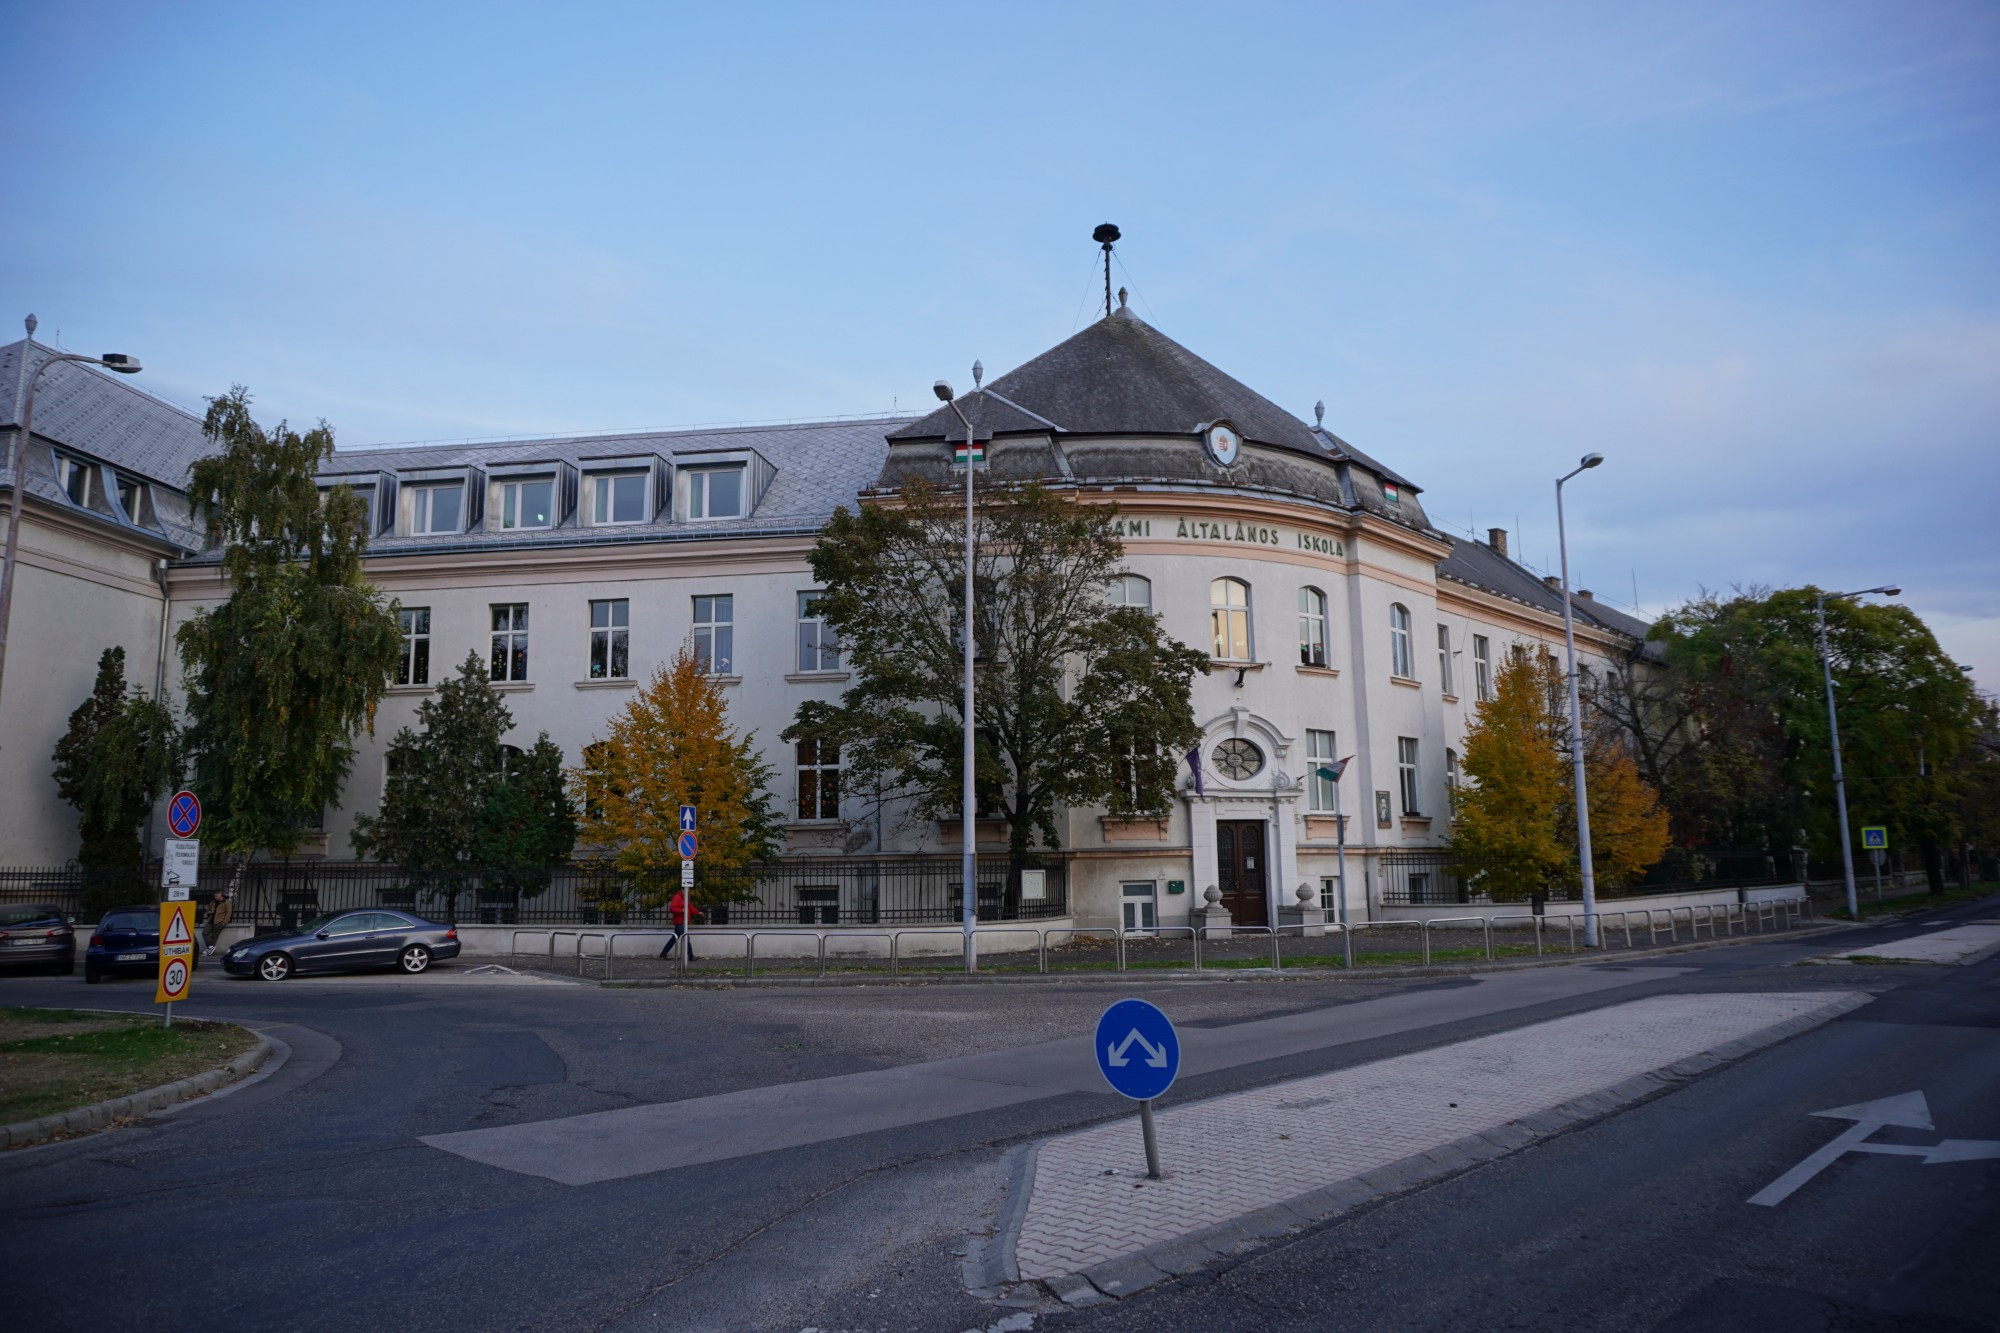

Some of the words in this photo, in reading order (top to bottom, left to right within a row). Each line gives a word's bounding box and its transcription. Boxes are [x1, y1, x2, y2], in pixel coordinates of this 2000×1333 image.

[1101, 520, 1150, 537] AMI
[1177, 516, 1279, 545] ÁLTALÁNOS
[1297, 533, 1344, 557] ISKOLA
[164, 945, 190, 955] ÚTHIBÁK
[169, 970, 182, 985] 30
